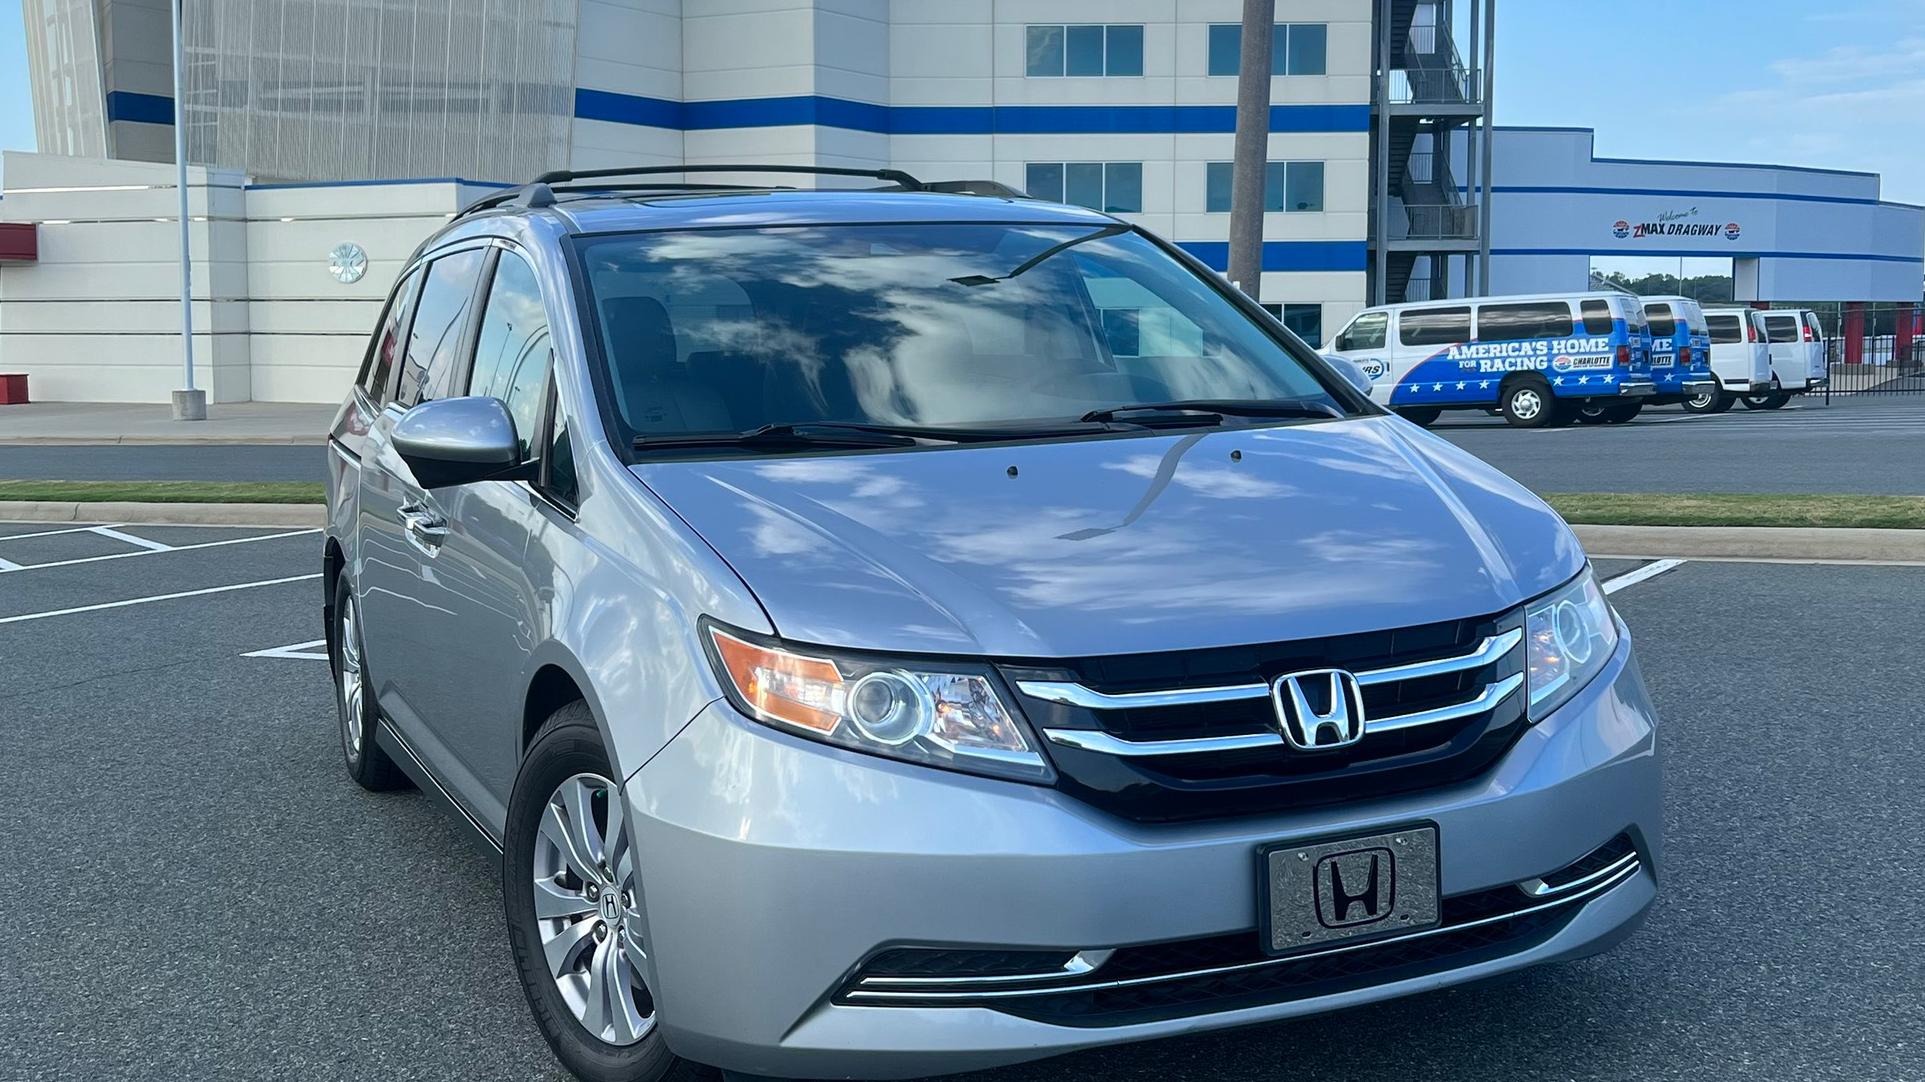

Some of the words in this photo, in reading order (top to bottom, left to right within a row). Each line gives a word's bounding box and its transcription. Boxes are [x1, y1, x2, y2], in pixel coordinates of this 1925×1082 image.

[1656, 209, 1689, 222] Welcome
[1667, 224, 1722, 236] DRAGWAY
[1447, 340, 1548, 360] AMERICA'S
[1552, 338, 1609, 354] HOME
[1459, 360, 1477, 369] FOR
[1480, 356, 1548, 373] RACING
[1573, 356, 1610, 366] CHARLOTTE
